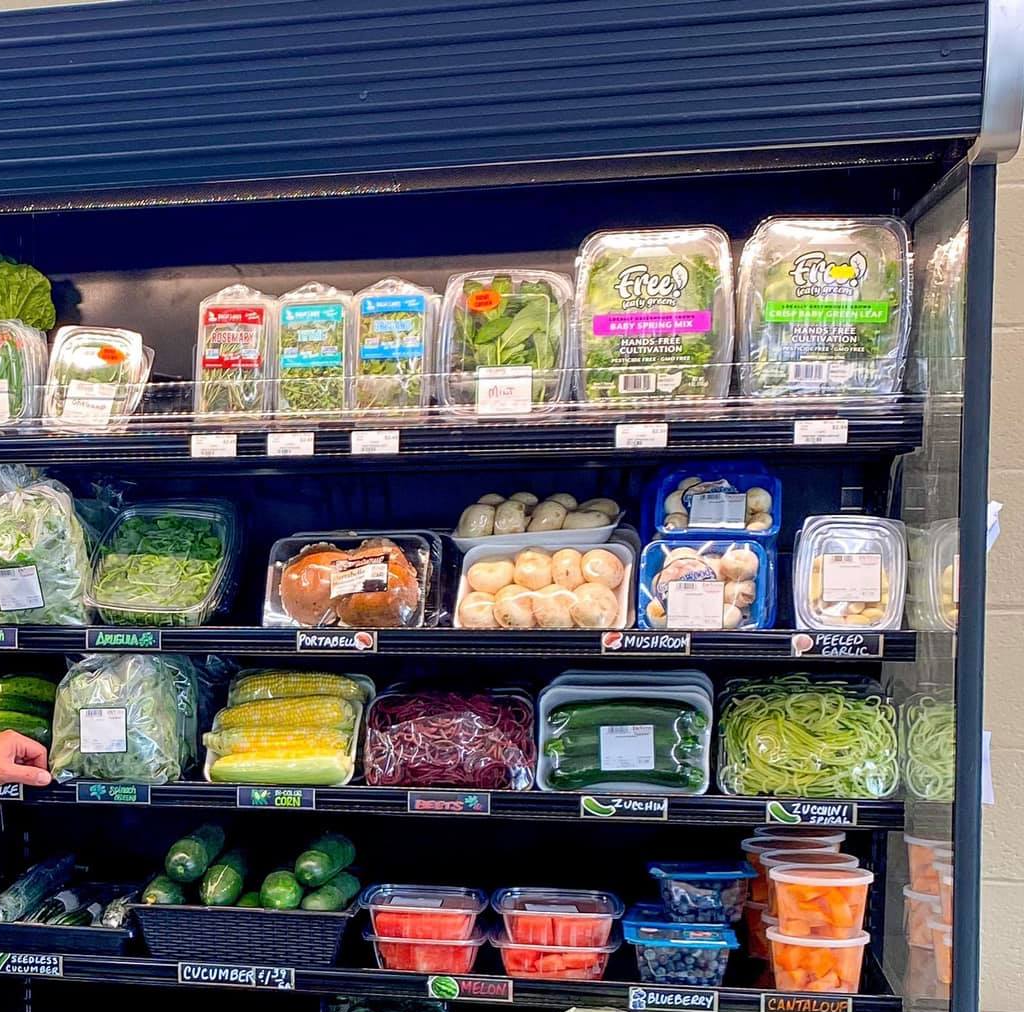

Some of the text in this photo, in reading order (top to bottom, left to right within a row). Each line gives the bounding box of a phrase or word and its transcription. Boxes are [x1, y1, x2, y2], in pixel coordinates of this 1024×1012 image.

[673, 320, 693, 328] MIX
[791, 335, 858, 344] CULTIVATION
[619, 345, 683, 354] CULTIVATION
[624, 635, 690, 649] MUSHROOM
[816, 633, 864, 646] PEELED
[822, 646, 870, 656] GARLIC
[274, 796, 301, 807] CORN
[10, 954, 59, 965] SEEDLESS
[5, 964, 61, 976] CUCUMBER
[183, 965, 256, 984] CUCUMBER
[460, 980, 508, 996] MELON
[647, 993, 714, 1009] BLUEBERRY
